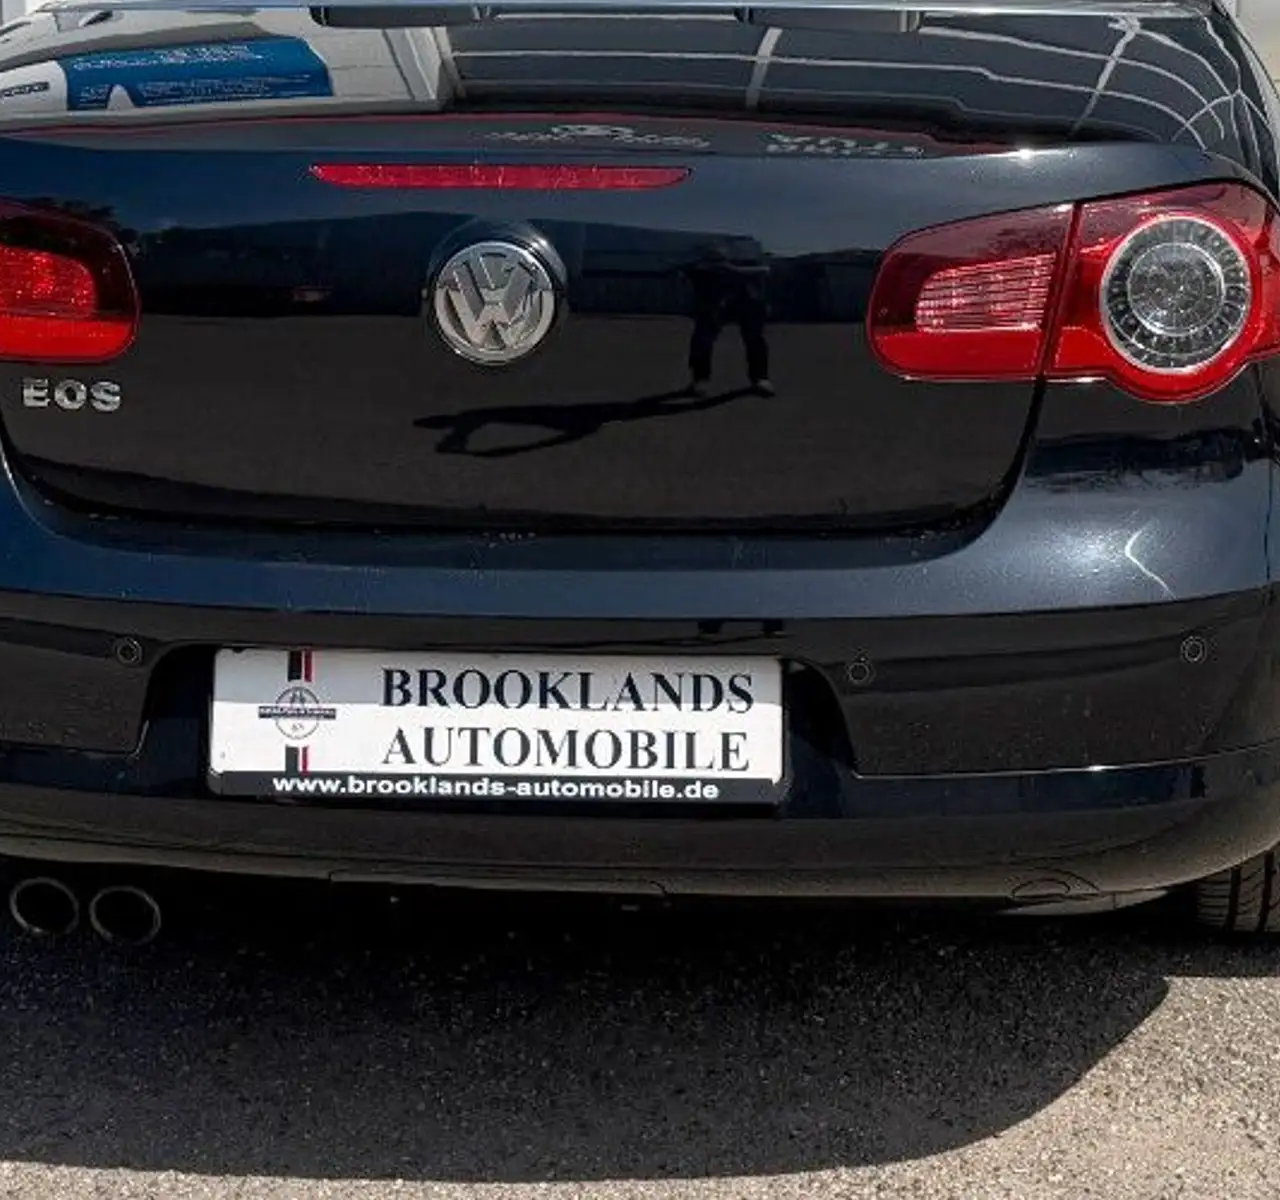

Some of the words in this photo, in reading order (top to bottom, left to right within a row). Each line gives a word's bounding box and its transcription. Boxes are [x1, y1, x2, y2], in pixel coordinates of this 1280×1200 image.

[23, 379, 121, 412] EOS
[381, 668, 755, 714] BROOKLANDS
[381, 727, 751, 773] AUTOMOBILE
[272, 774, 719, 800] www.brooklands-automobile.de
